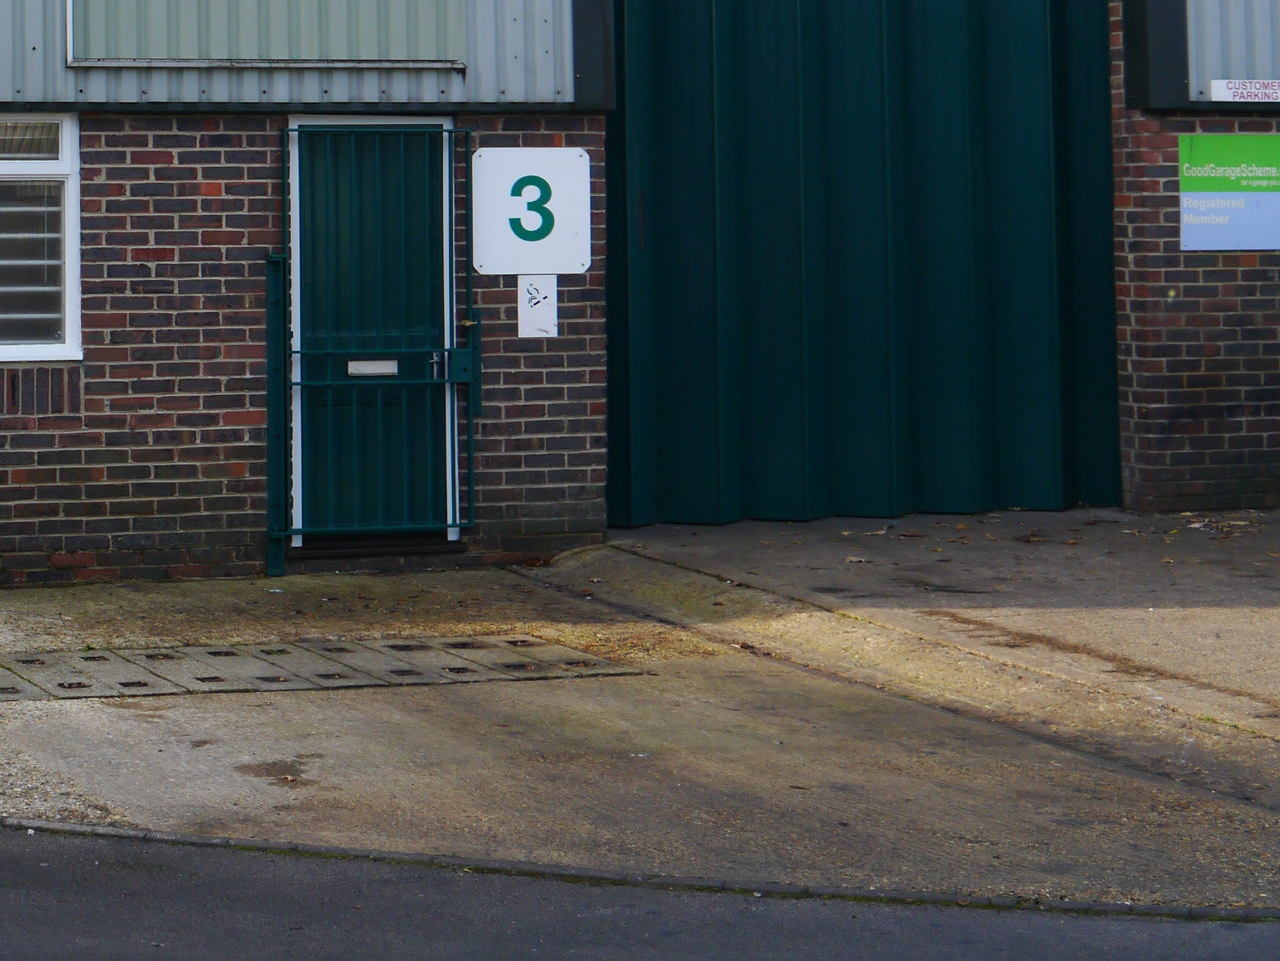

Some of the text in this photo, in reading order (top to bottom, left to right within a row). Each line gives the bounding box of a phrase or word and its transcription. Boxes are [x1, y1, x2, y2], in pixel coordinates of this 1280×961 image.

[1232, 91, 1279, 100] PARKING
[508, 174, 555, 242] 3
[1184, 197, 1245, 210] Registered
[1184, 214, 1229, 223] Member
